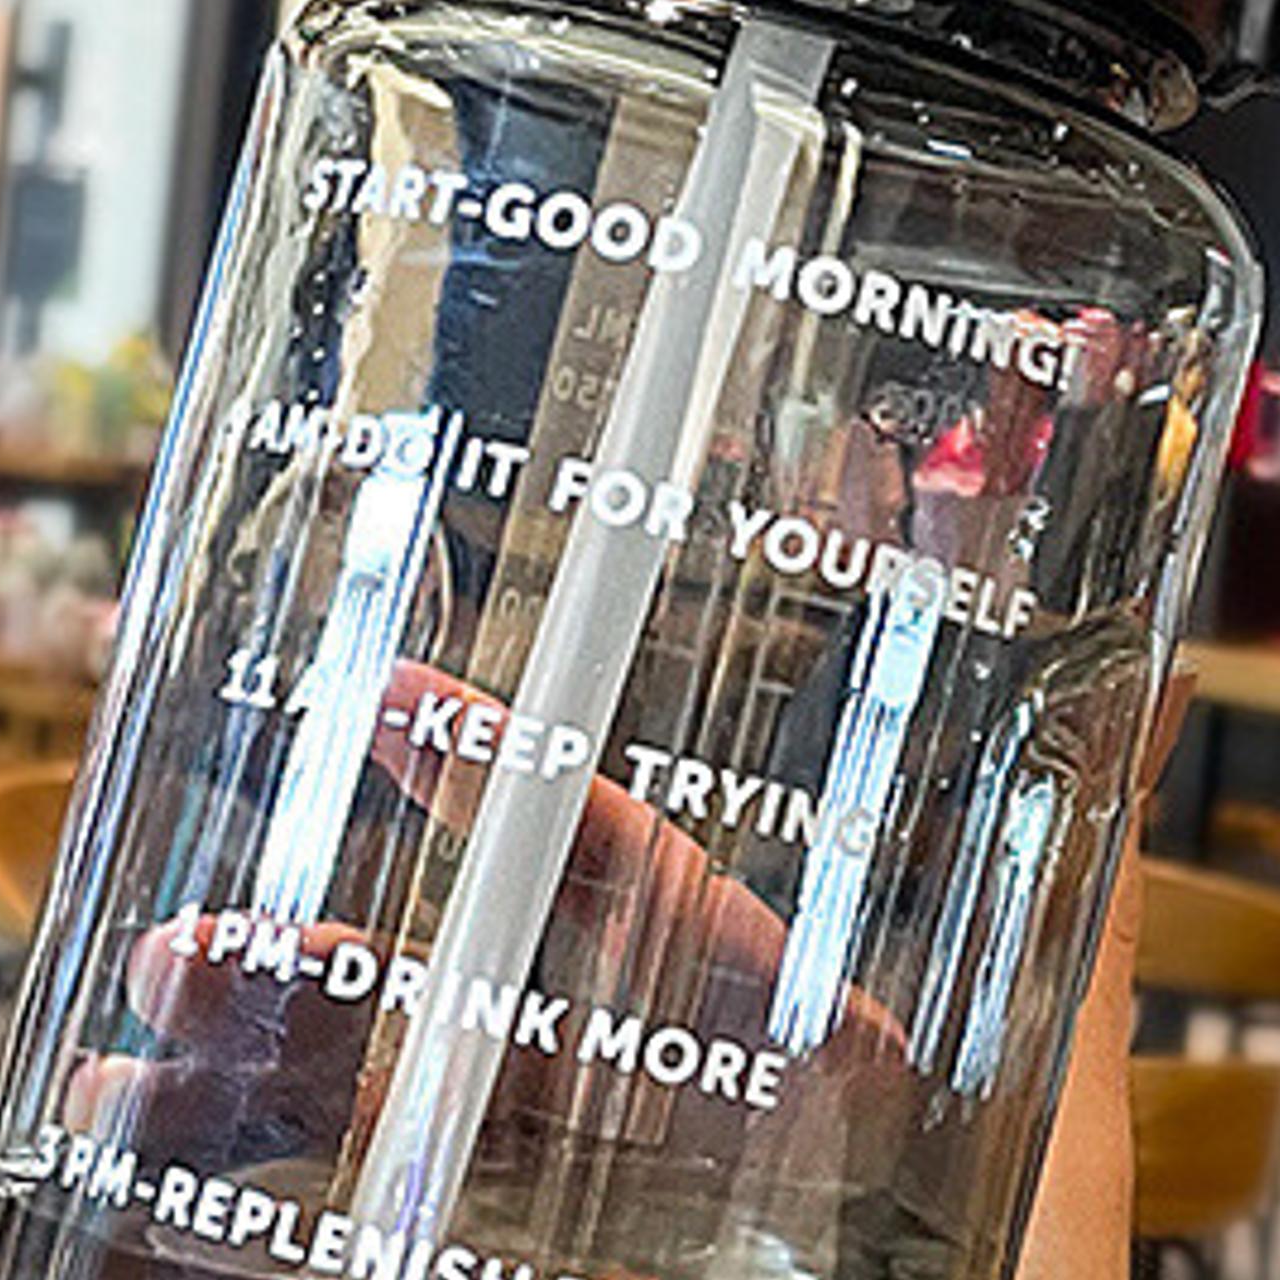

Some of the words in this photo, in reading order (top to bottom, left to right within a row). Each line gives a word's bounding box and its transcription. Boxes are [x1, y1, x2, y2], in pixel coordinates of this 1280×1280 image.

[304, 160, 702, 272] START-GOOD
[732, 237, 1085, 391] MORNING!
[457, 437, 530, 498] IT
[549, 457, 694, 540] FOR
[729, 501, 1038, 639] YOURSELF
[220, 647, 280, 710] 11
[624, 743, 874, 856] TRYING
[208, 910, 569, 1055] PM-DRINK
[577, 1007, 787, 1108] MORE
